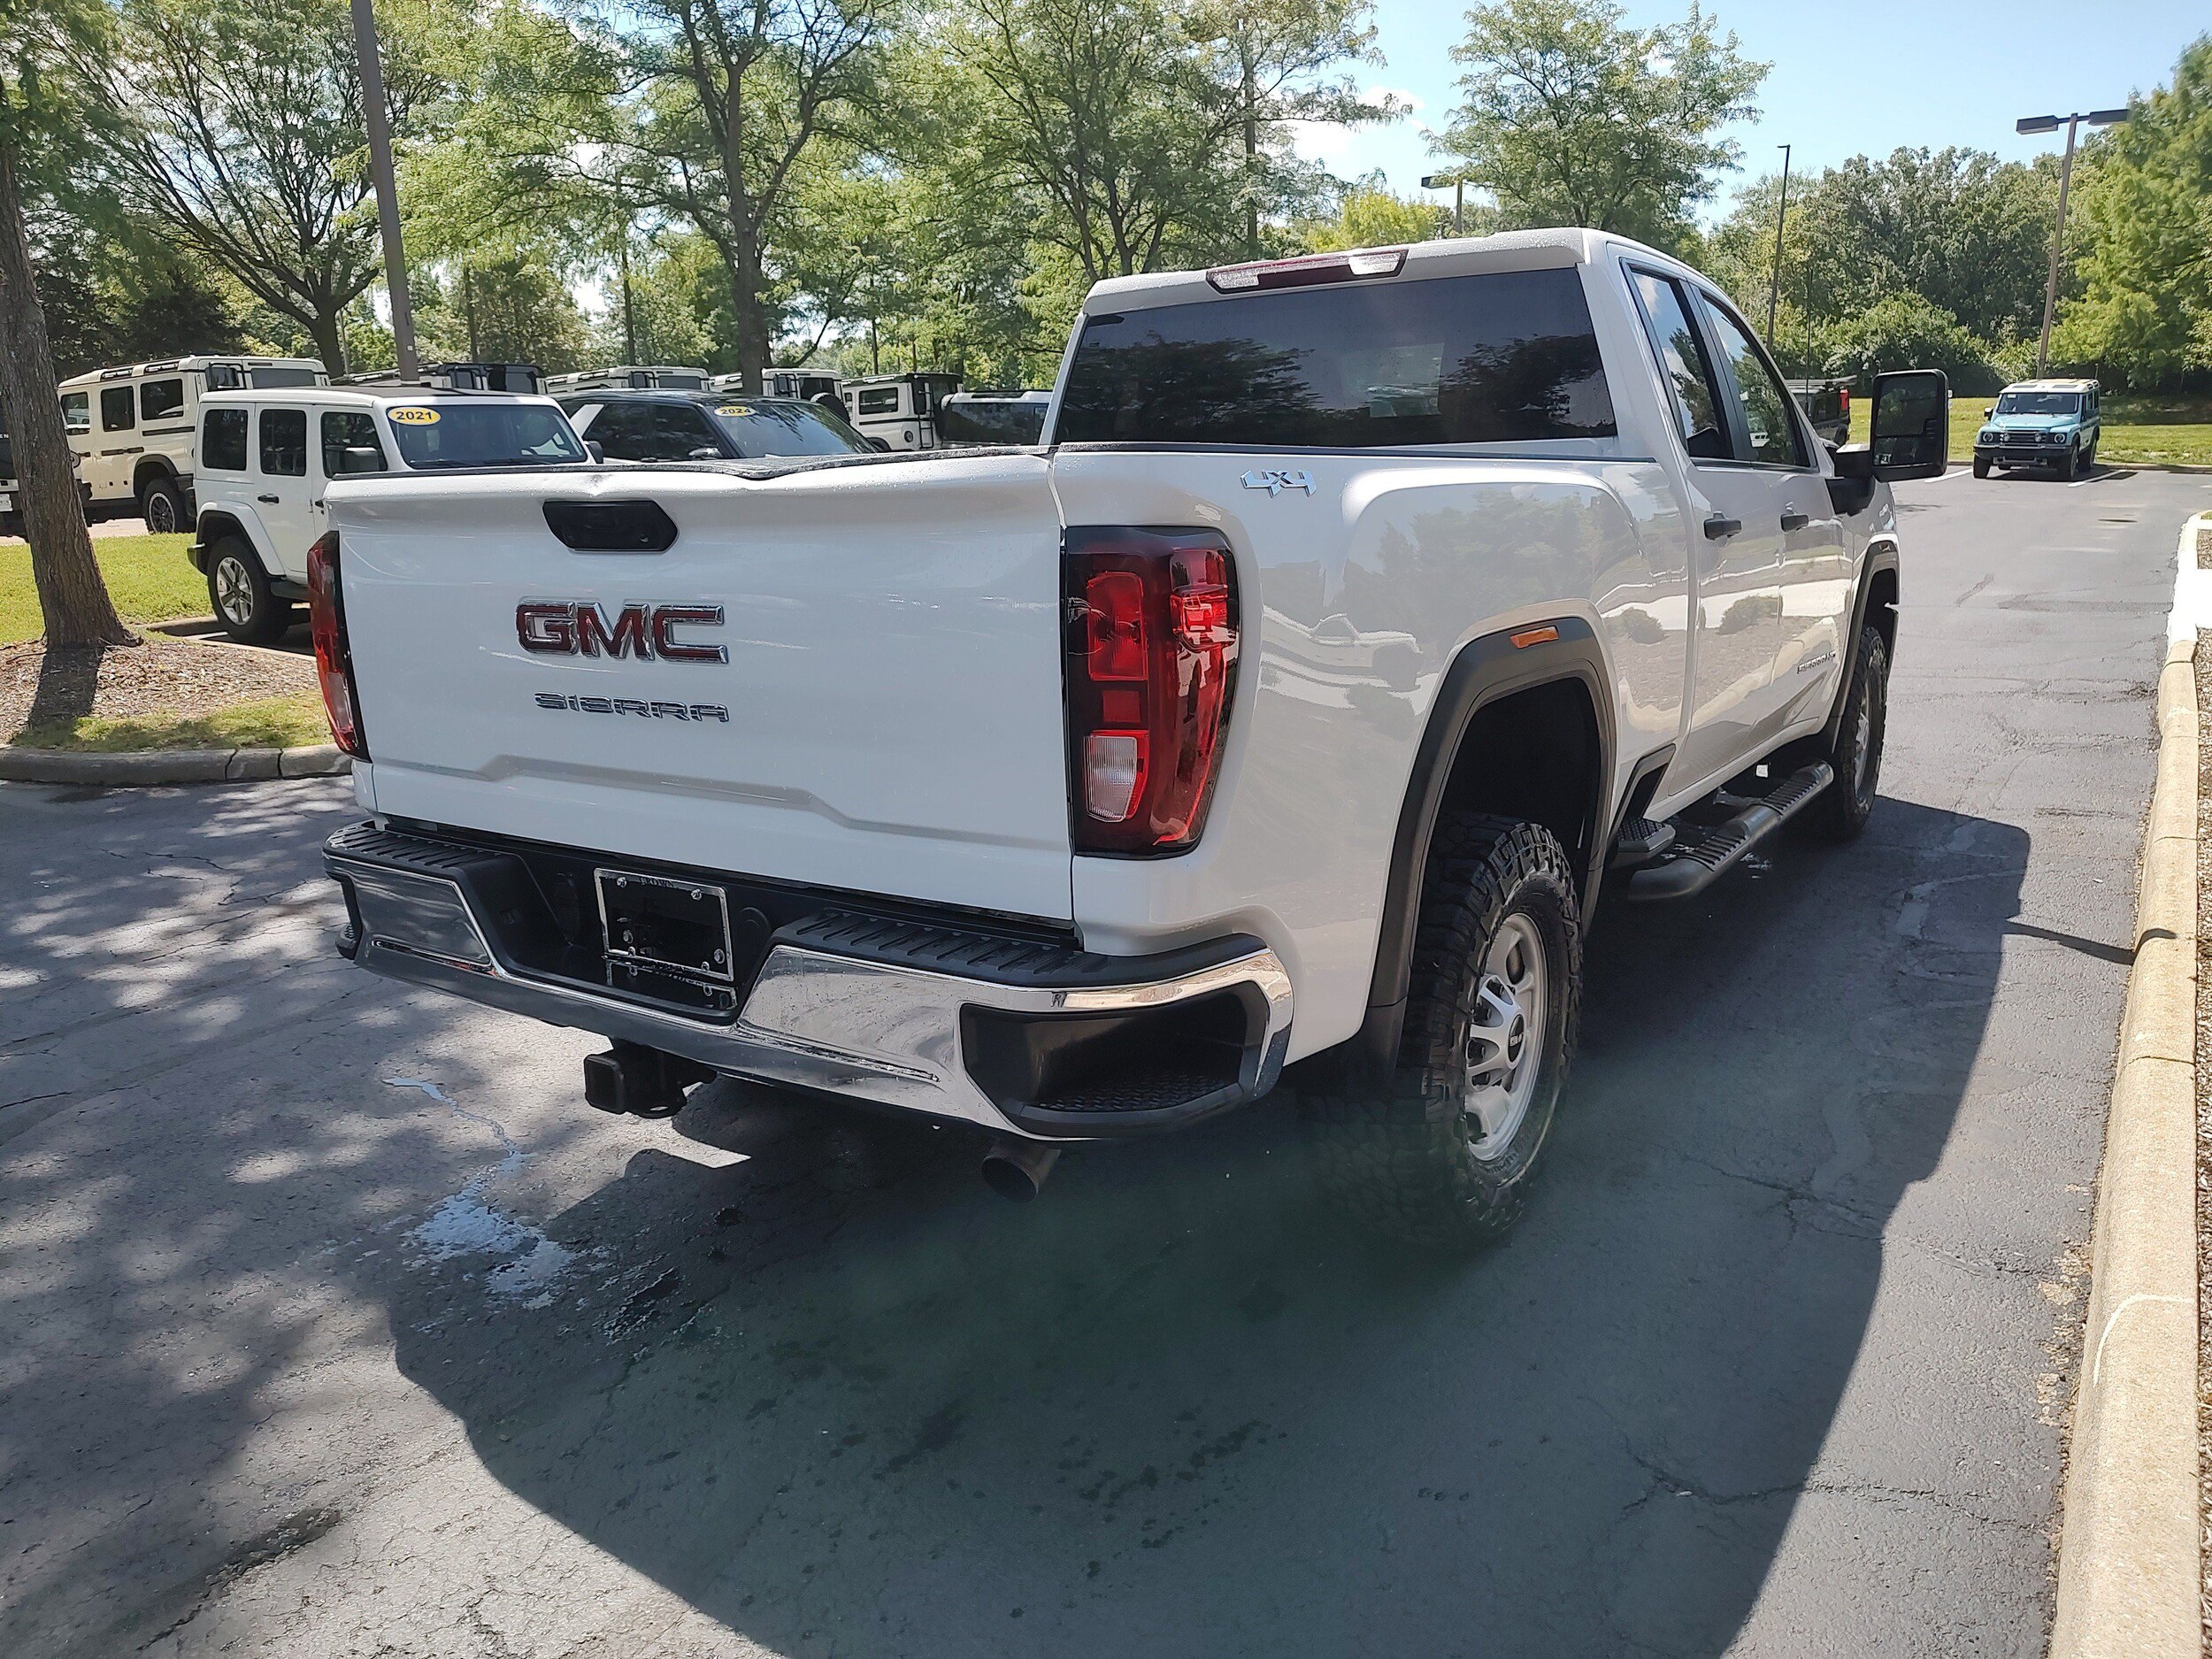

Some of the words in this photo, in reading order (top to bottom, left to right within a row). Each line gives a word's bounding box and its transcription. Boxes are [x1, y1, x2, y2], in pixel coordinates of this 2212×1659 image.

[396, 411, 433, 420] 2021
[516, 601, 729, 664] GMC
[534, 691, 730, 723] SIERRA
